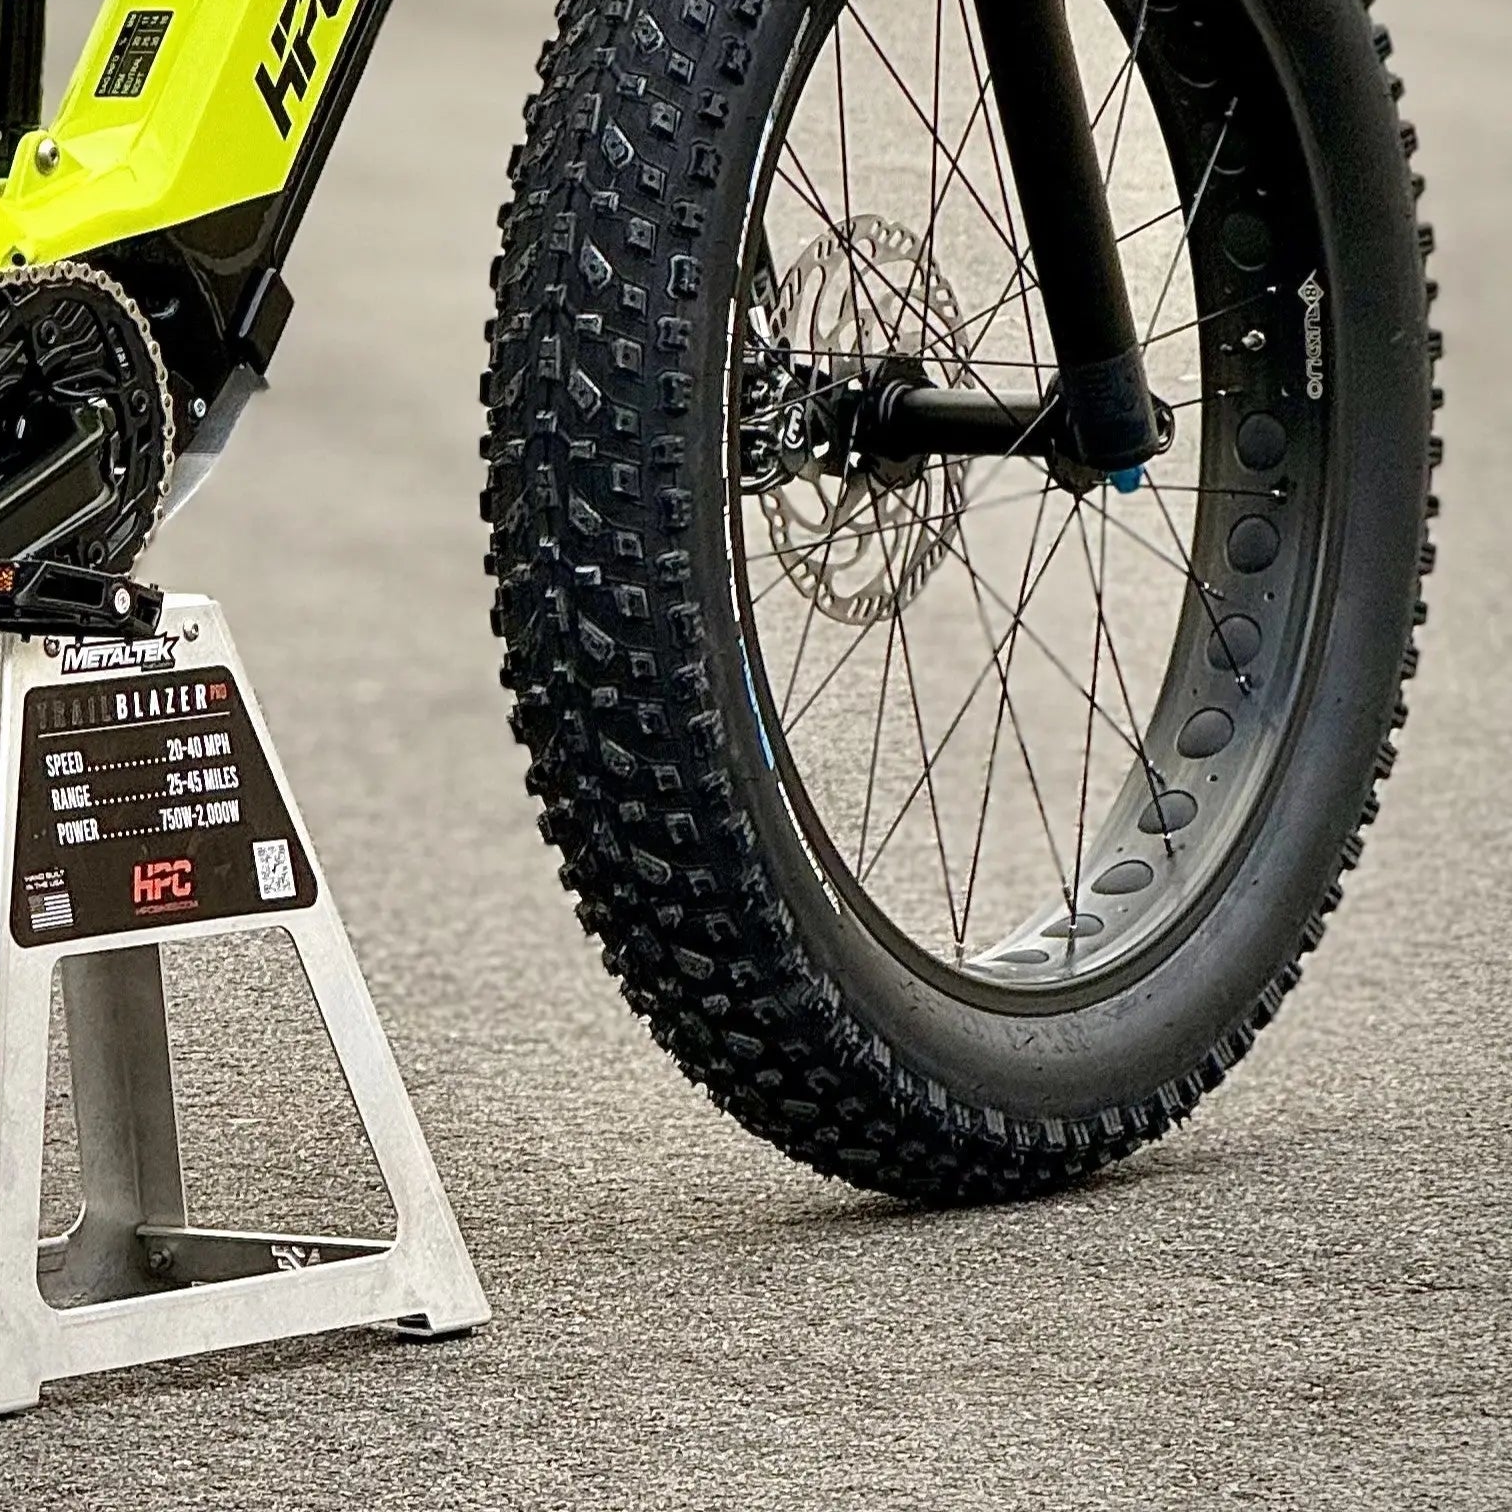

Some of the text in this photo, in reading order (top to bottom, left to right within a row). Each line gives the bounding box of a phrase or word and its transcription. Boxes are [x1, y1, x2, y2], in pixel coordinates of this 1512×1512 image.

[64, 637, 176, 671] METALTEK
[209, 683, 227, 701] PRO
[45, 732, 230, 777] SPEED 20-40 MPH
[51, 766, 239, 811] RANGE 25-45 MILES
[57, 799, 240, 845] POWER 750W-2,000W
[132, 859, 191, 903] HPC
